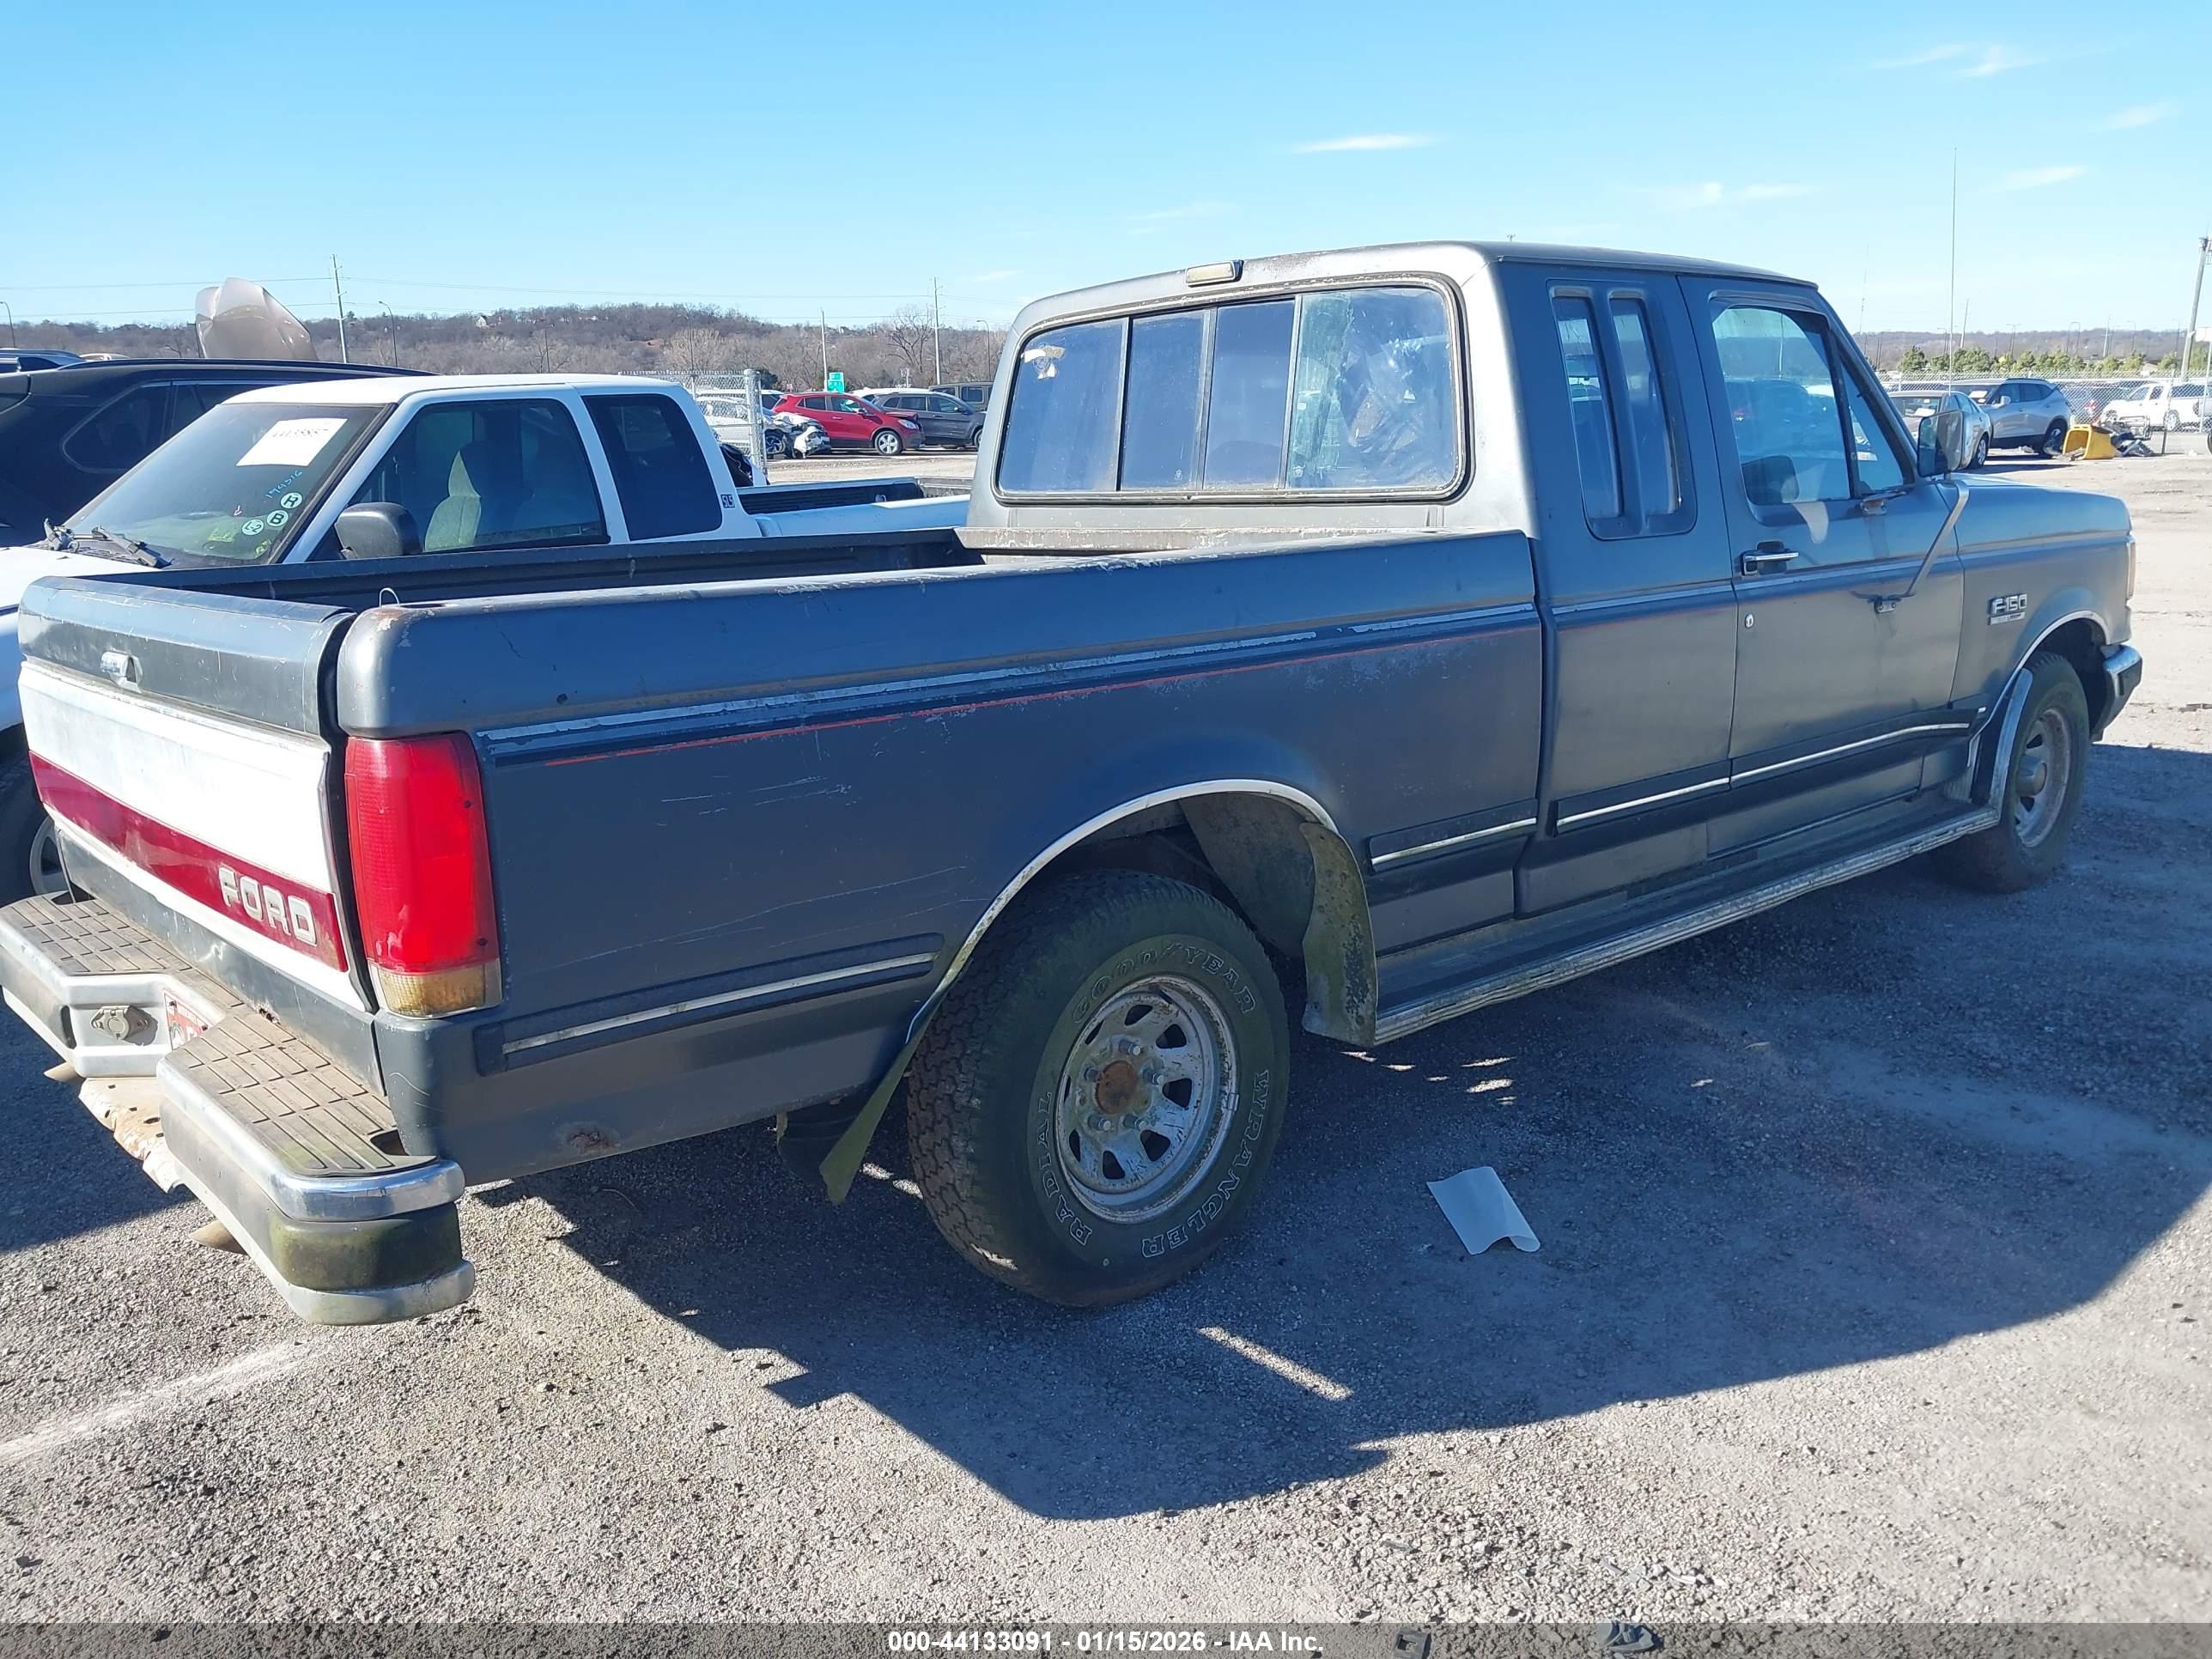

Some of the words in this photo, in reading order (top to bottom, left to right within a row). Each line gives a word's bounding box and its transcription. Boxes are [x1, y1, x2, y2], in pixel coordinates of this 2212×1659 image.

[218, 866, 318, 947] FORD
[1037, 1091, 1093, 1246] RADIAL
[1141, 1069, 1270, 1258] WRANGLER
